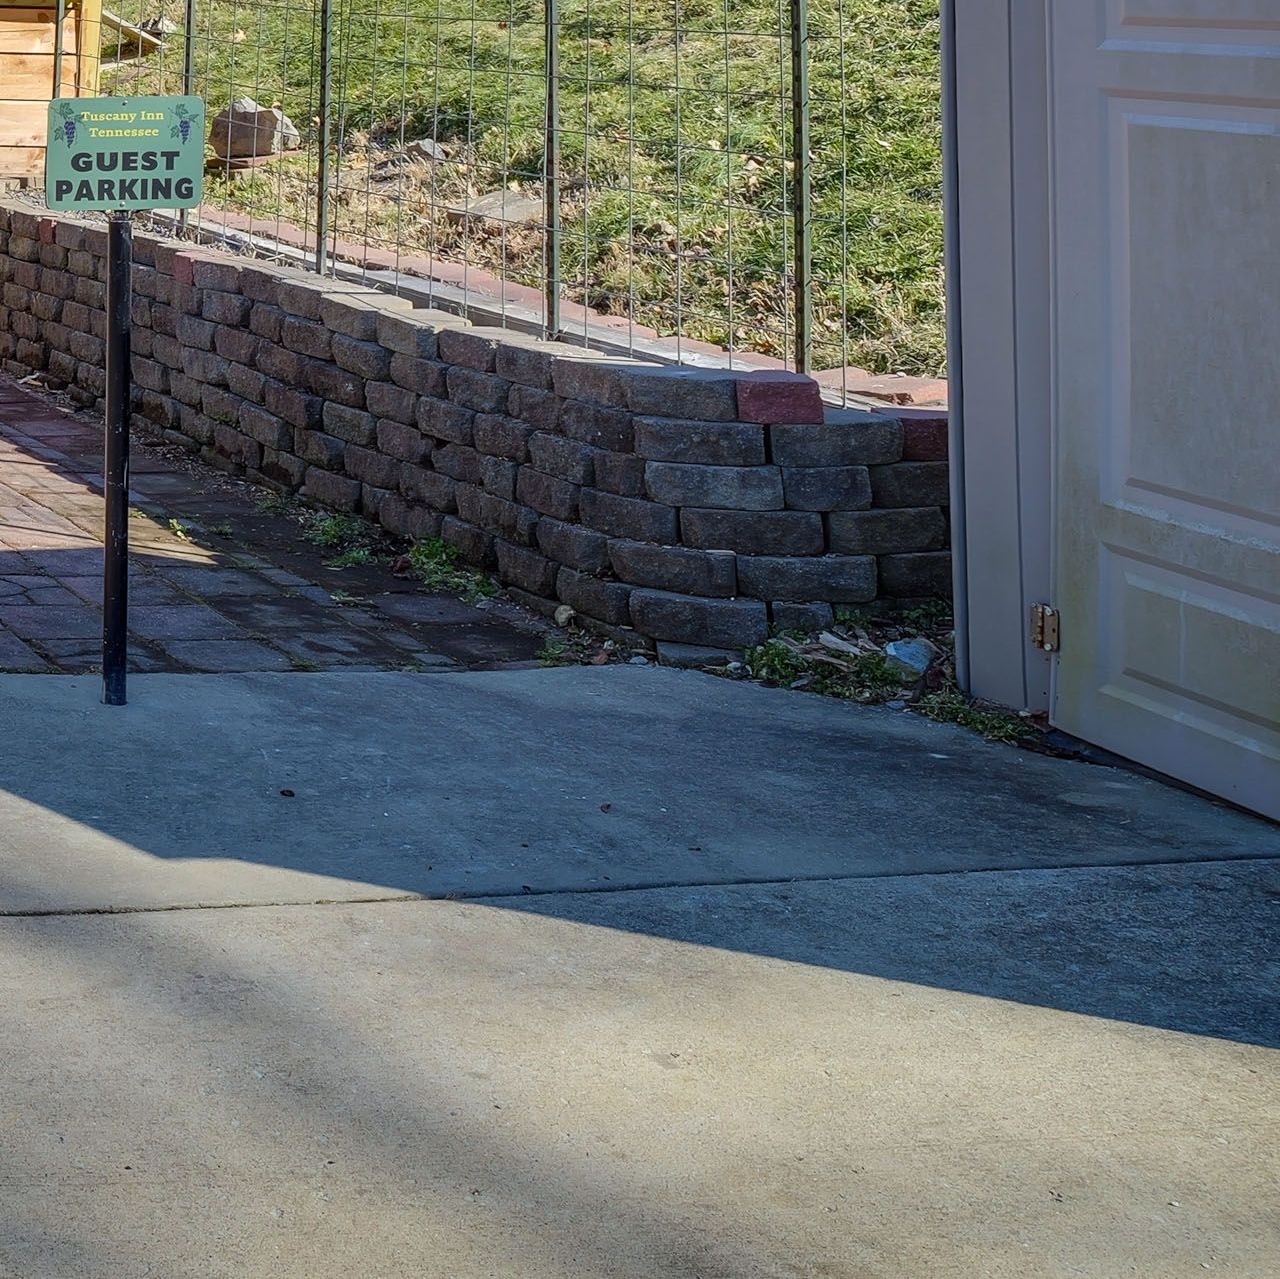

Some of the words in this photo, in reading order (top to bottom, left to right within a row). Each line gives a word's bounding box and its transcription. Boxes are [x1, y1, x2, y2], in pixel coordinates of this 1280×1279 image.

[81, 111, 137, 123] Tuscany
[140, 110, 165, 121] Inn
[89, 128, 160, 138] Tennessee
[70, 151, 180, 172] GUEST
[55, 178, 194, 201] PARKING
